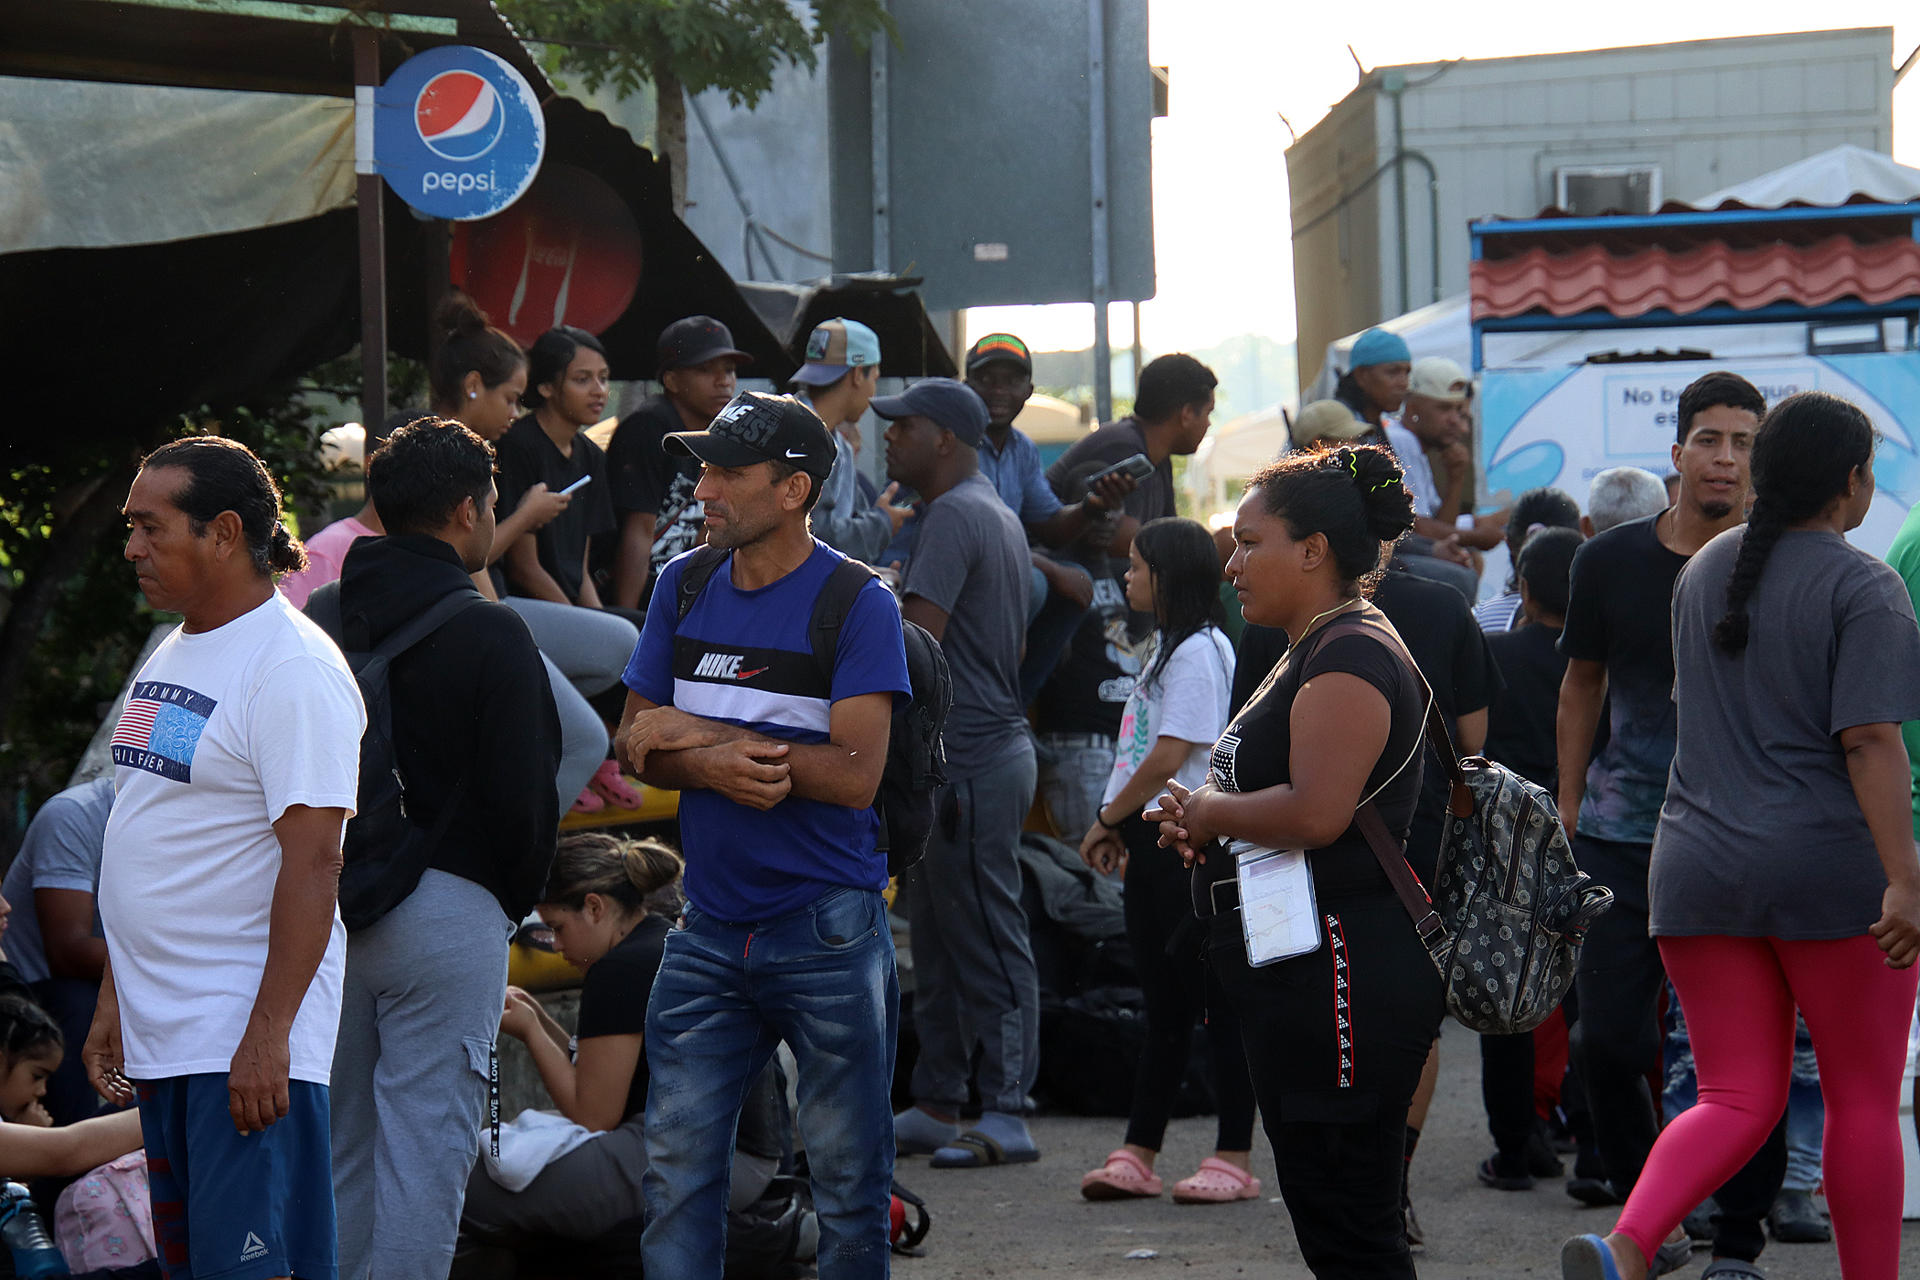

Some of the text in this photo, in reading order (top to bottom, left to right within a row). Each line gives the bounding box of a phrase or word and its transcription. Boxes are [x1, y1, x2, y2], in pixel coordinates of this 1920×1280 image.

[422, 168, 496, 196] pepsi
[1622, 386, 1653, 405] No
[693, 652, 744, 680] NIKE
[139, 684, 194, 705] TOMMY
[491, 1098, 499, 1123] LOVE
[240, 1248, 270, 1263] Reebok
